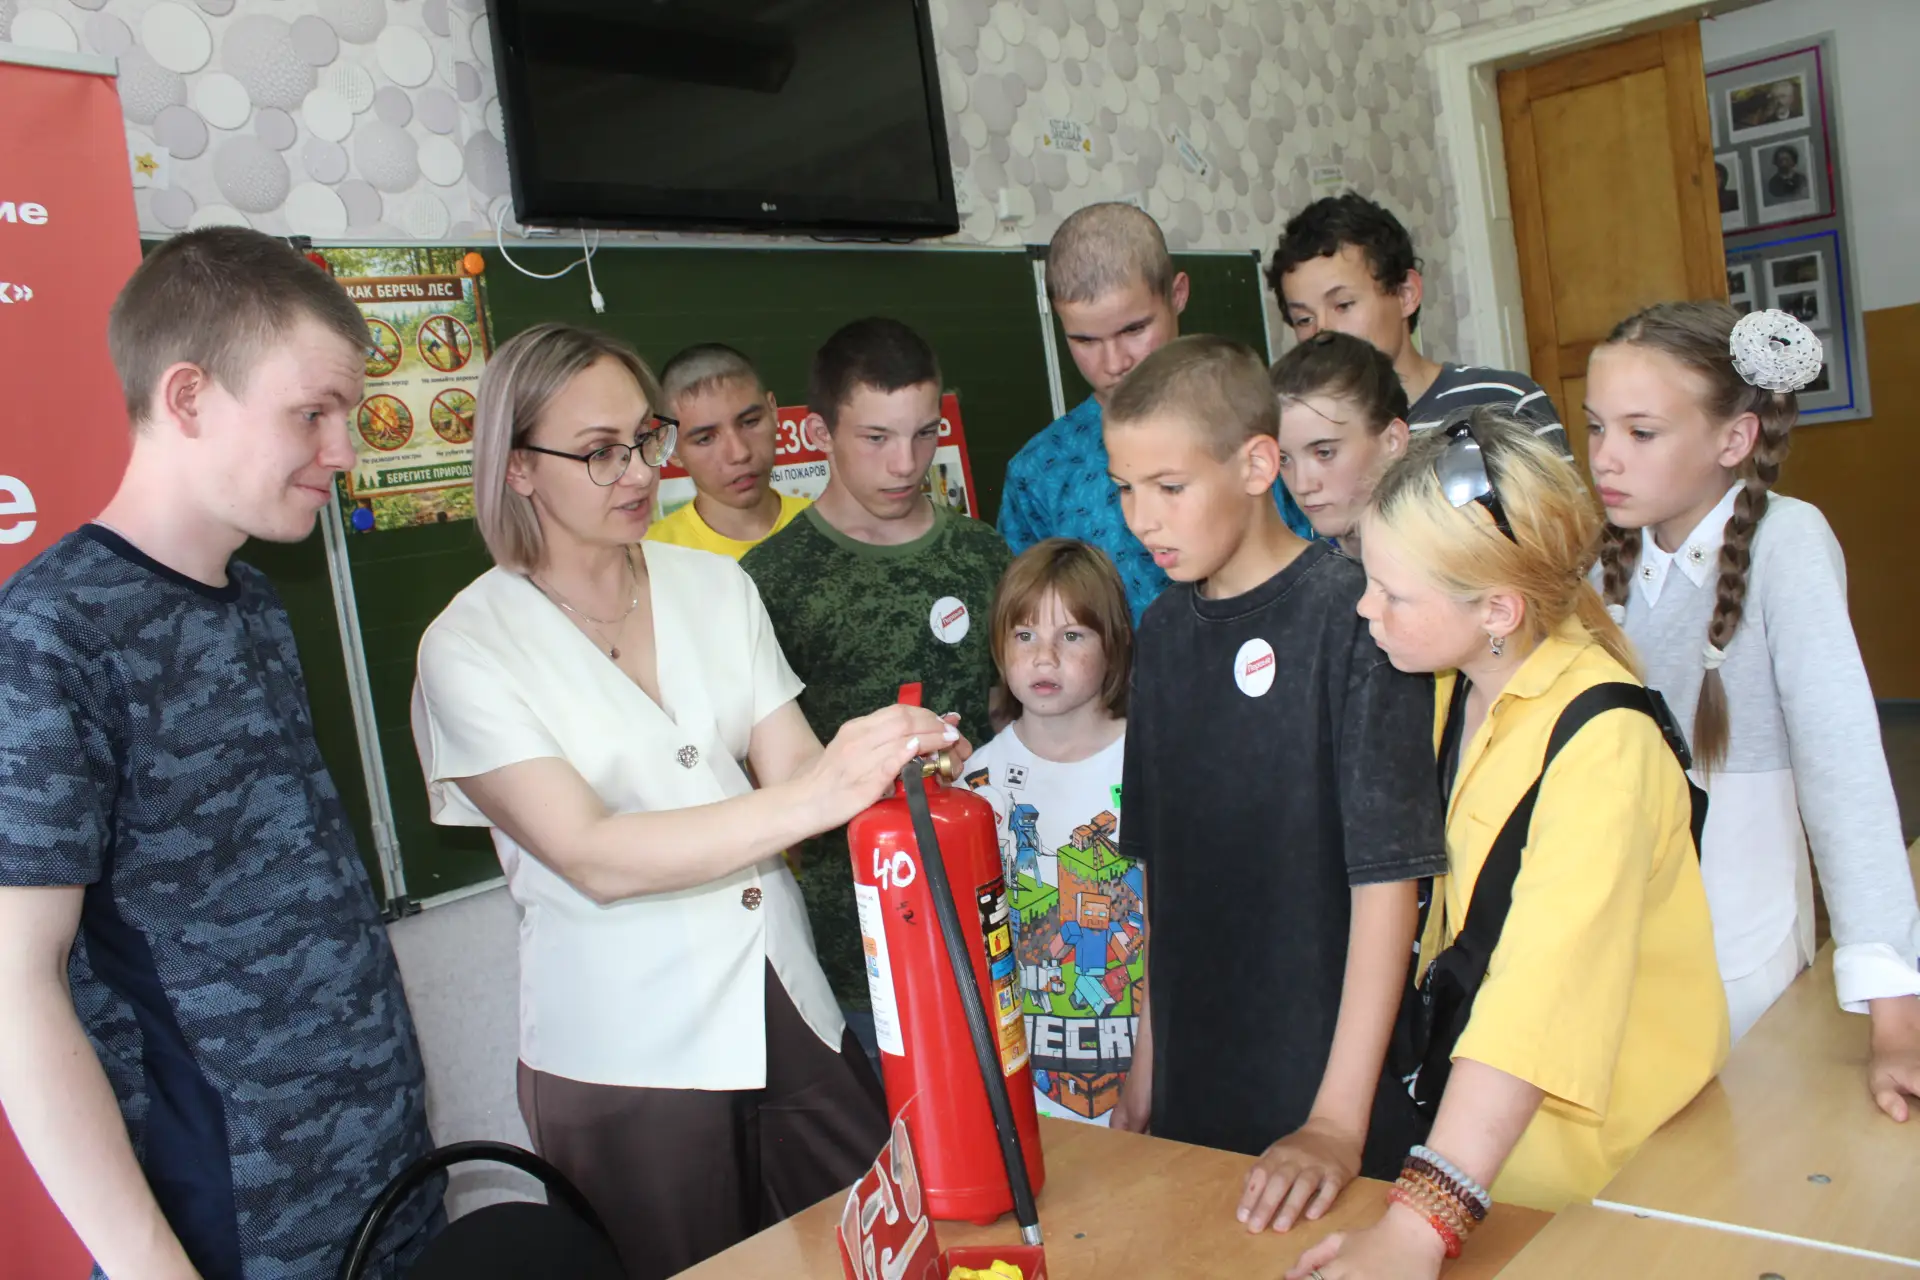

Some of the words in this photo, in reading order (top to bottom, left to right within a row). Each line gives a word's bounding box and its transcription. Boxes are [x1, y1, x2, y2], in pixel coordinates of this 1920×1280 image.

[345, 284, 374, 299] КАК
[376, 283, 424, 298] БЕРЕЧЬ
[428, 282, 455, 296] ЛЕС
[386, 470, 431, 484] БЕРЕГИТЕ
[784, 465, 827, 480] ПОЖАРОВ
[873, 847, 917, 891] 40
